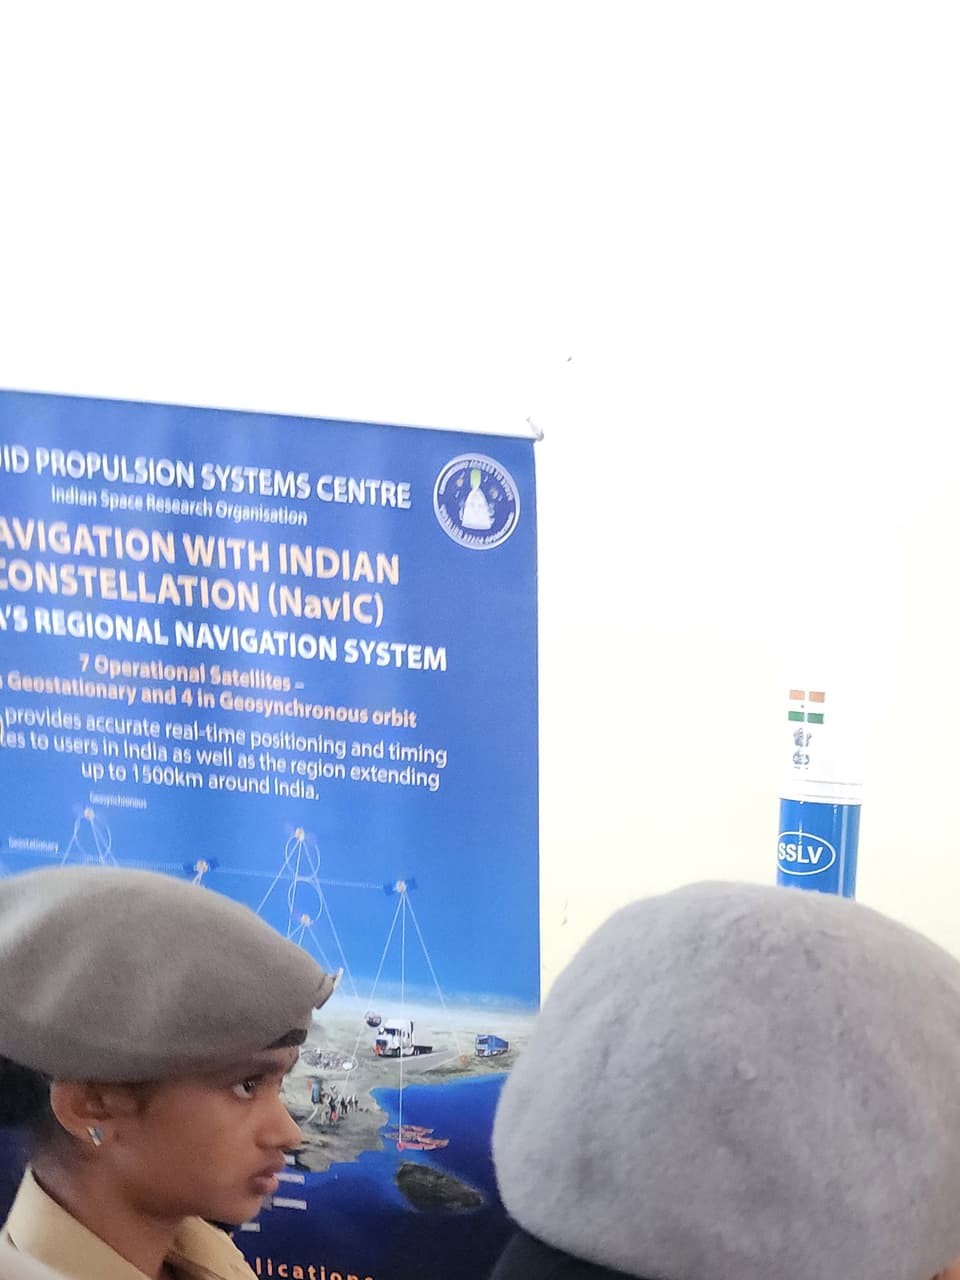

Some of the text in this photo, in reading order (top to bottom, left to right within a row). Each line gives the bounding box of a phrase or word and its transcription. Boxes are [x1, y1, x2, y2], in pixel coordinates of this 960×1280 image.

[0, 443, 29, 473] ID
[35, 446, 195, 489] PROPULSION
[200, 462, 312, 500] SYSTEMS
[316, 474, 412, 510] CENTRE
[51, 483, 308, 527] Indian Space Research Organisation
[182, 532, 270, 573] WITH
[278, 542, 400, 586] INDIAN
[268, 581, 384, 628] (NavIC)
[34, 606, 169, 646] REGIONAL
[174, 620, 338, 662] NAVIGATION
[343, 637, 447, 672] SYSTEM
[79, 652, 90, 673] 7
[94, 653, 206, 684] Operational
[209, 665, 292, 692] Satellites
[7, 670, 137, 706] Geostationary
[140, 686, 177, 706] and
[181, 687, 193, 707] 4
[197, 688, 216, 709] in
[219, 691, 369, 724] Geosynchronous
[371, 707, 417, 729] orbit
[5, 705, 448, 769] provides accurate real-time positioning and timing
[30, 730, 49, 751] to
[53, 735, 99, 756] users
[103, 737, 119, 758] in
[124, 739, 168, 762] India
[172, 747, 192, 764] as
[196, 747, 233, 768] well
[237, 753, 256, 770] as
[259, 751, 287, 773] the
[290, 758, 346, 782] region
[350, 765, 441, 793] extending
[81, 761, 104, 783] up
[108, 763, 127, 781] to
[132, 762, 203, 789] 1500km
[208, 772, 270, 795] around
[778, 842, 824, 865] SSLV
